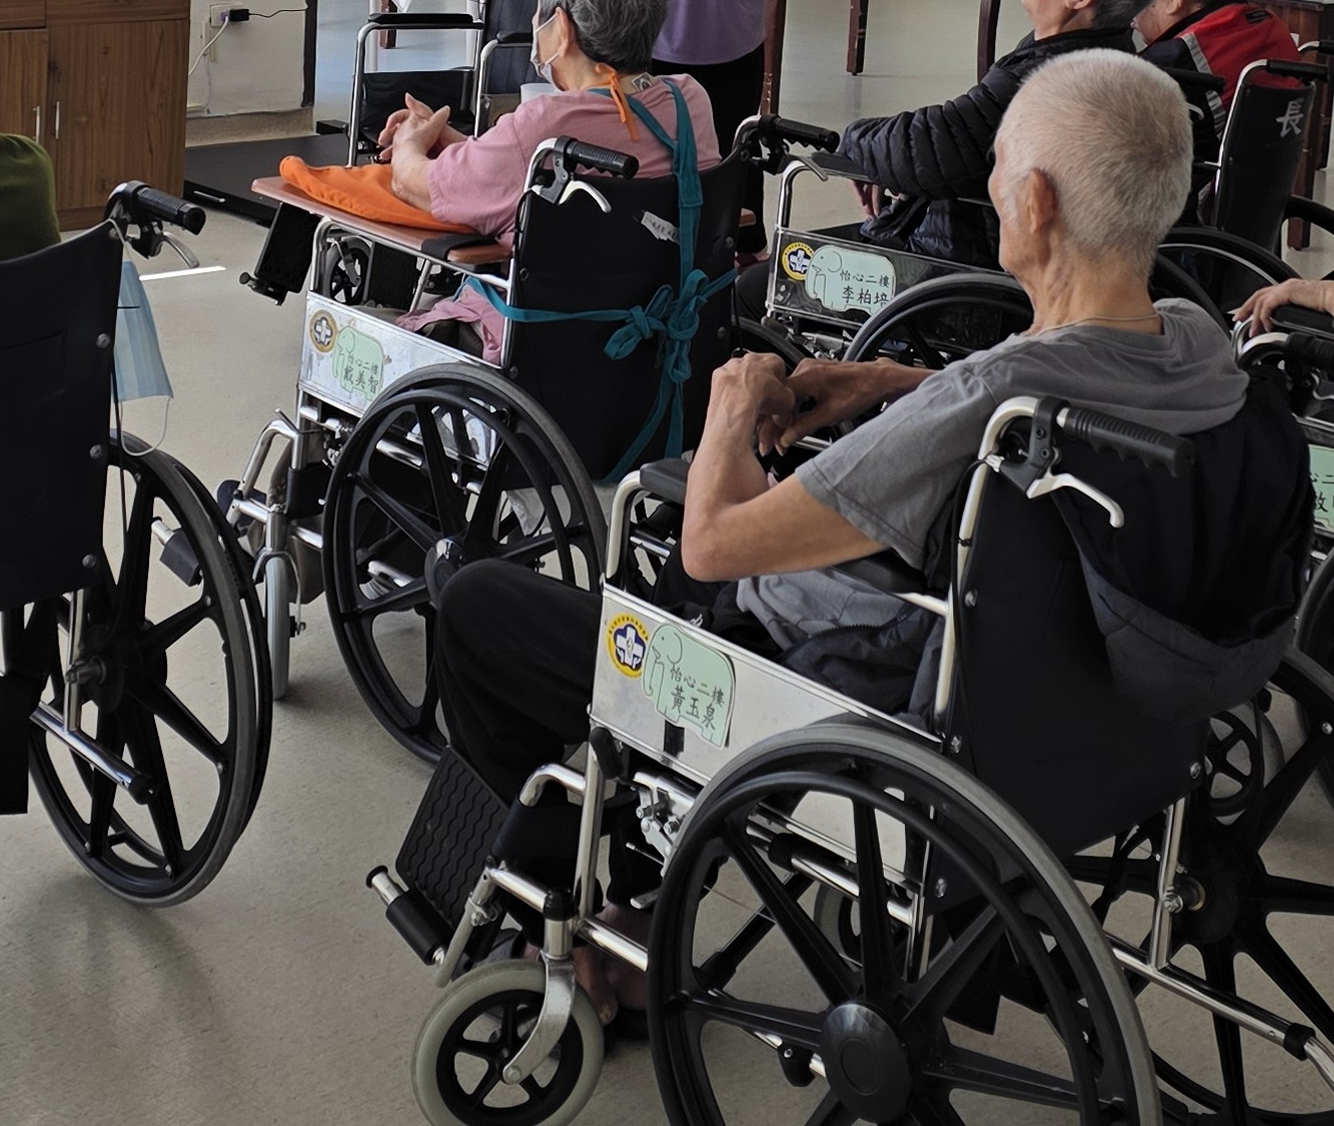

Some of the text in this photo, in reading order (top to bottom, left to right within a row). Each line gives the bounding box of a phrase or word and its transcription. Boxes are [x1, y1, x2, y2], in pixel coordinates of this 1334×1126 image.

[840, 269, 891, 289] 怡心二樓
[670, 666, 726, 706] 怡心二樓
[670, 686, 717, 731] 黃玉泉
